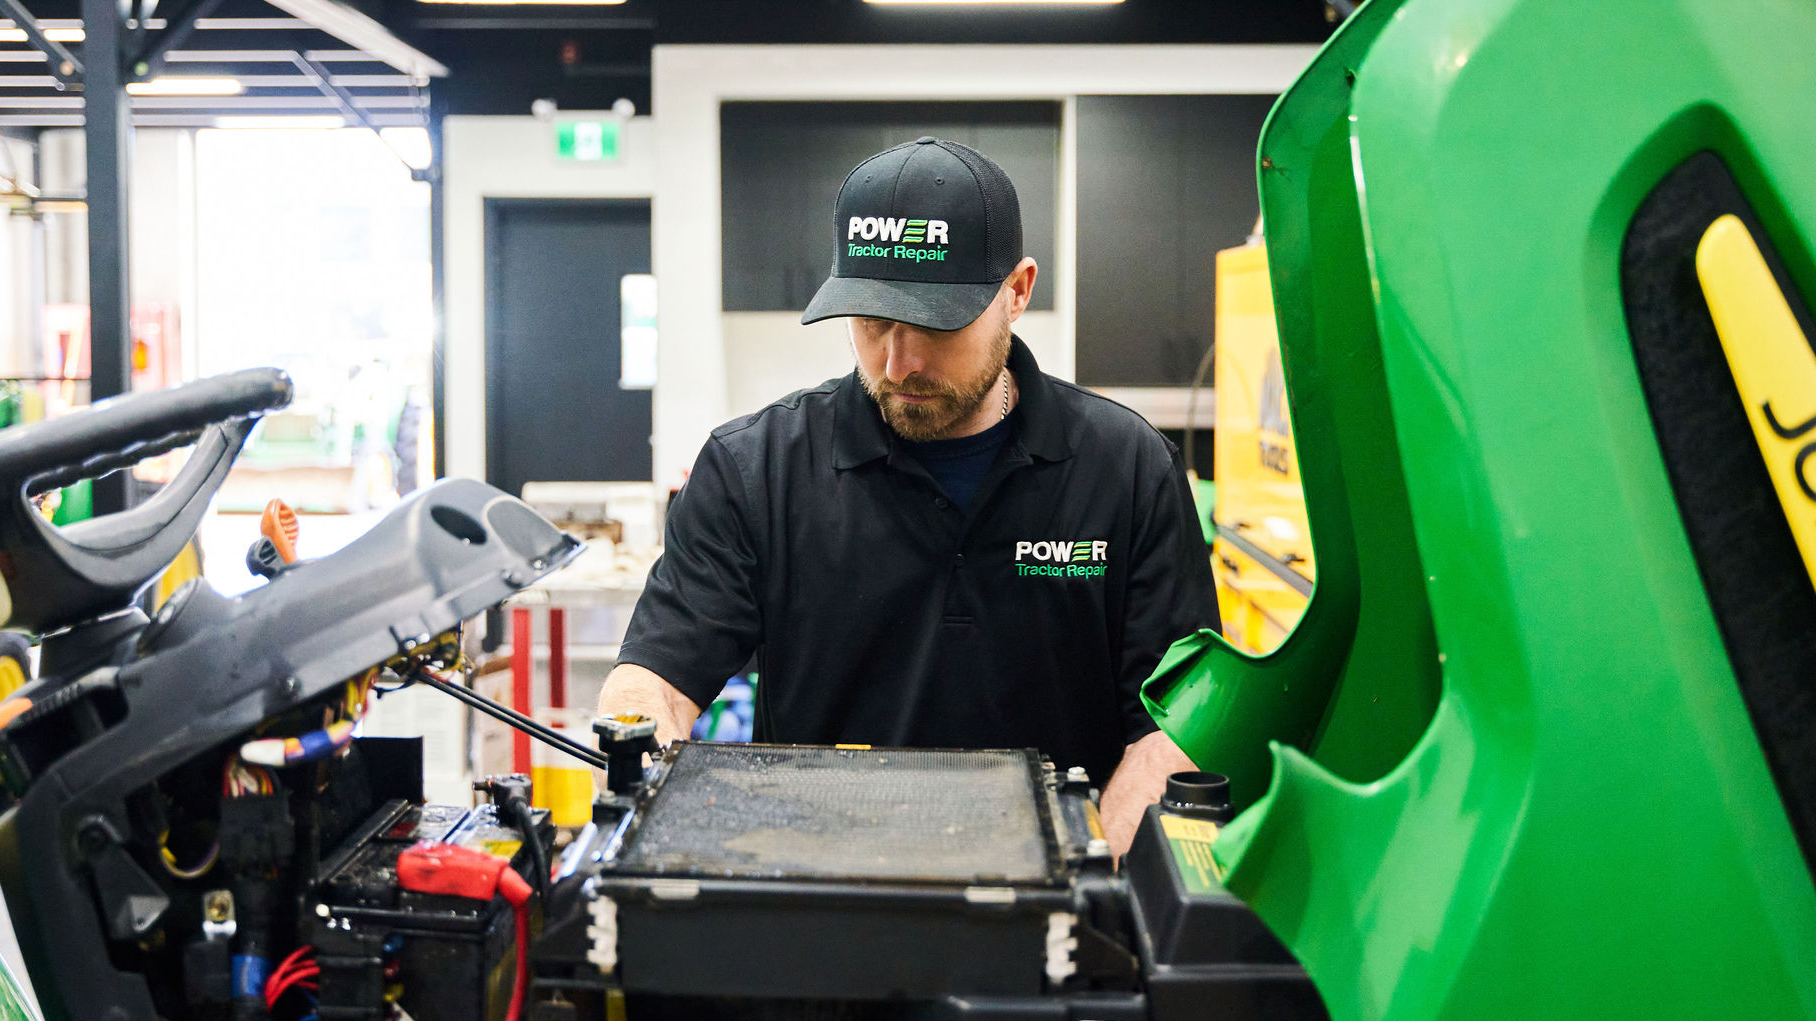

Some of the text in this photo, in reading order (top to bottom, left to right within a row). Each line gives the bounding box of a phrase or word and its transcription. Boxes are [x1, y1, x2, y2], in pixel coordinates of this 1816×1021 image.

[848, 216, 949, 244] POWER
[848, 243, 948, 263] Tractor Repair
[1015, 540, 1108, 562] POWER
[1015, 562, 1108, 580] Tractor Repair
